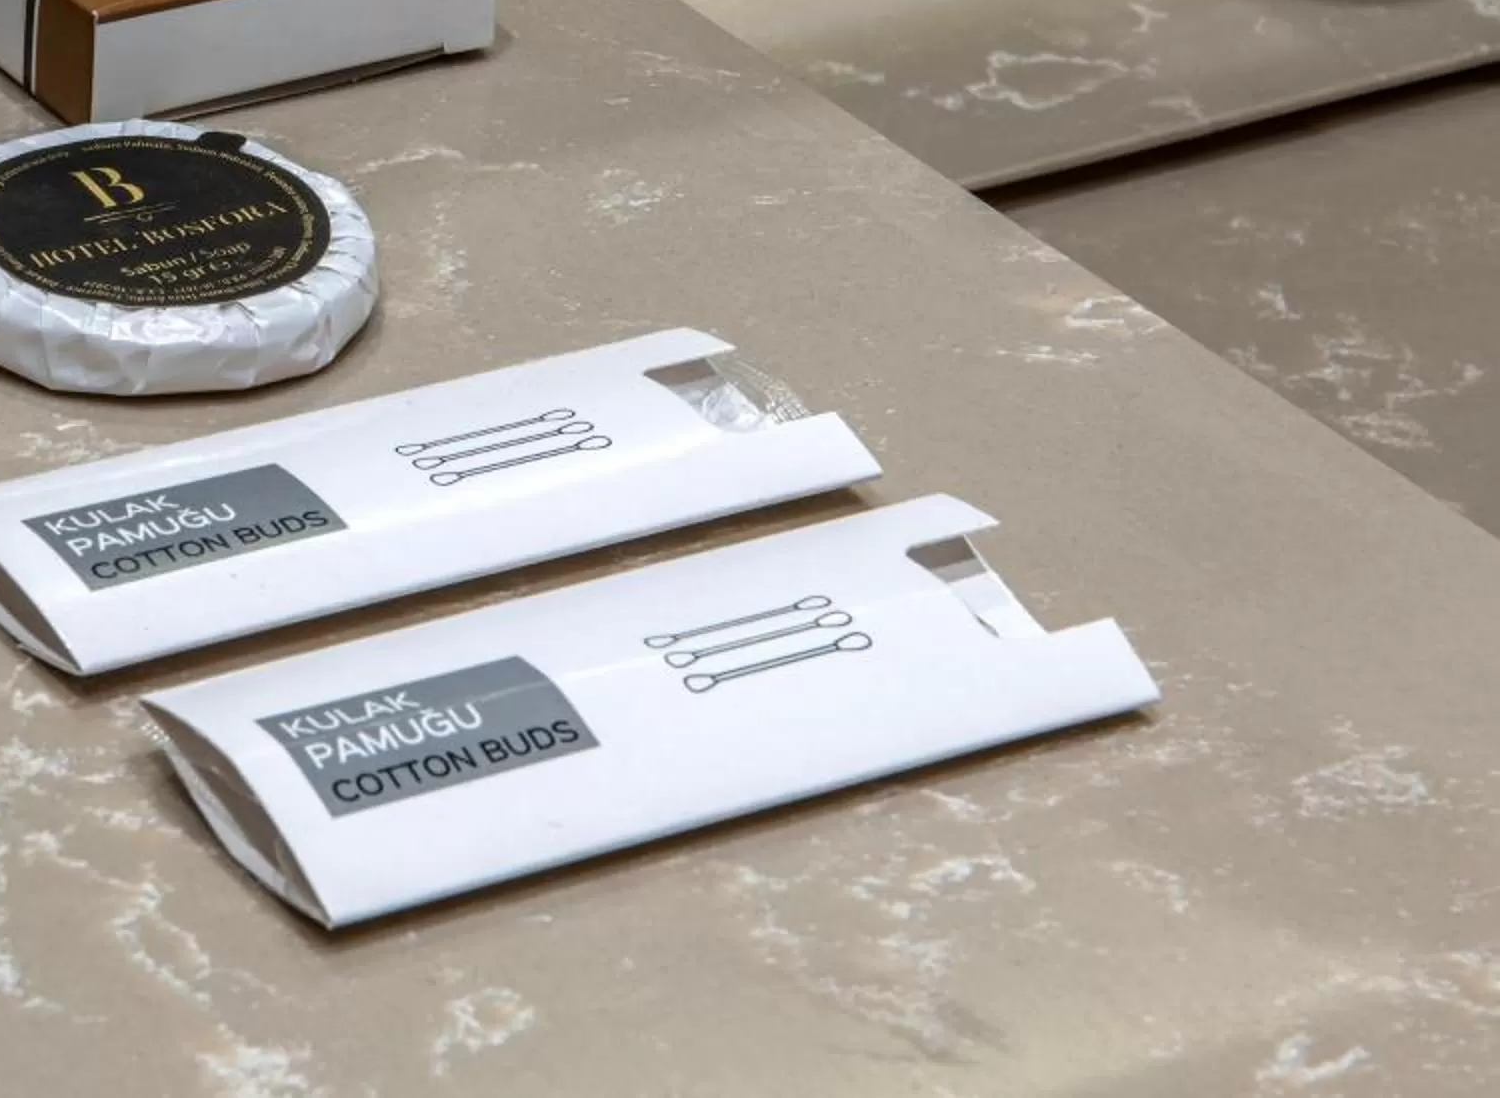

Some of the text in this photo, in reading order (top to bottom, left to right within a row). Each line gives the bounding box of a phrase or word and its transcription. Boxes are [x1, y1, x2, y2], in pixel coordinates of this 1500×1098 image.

[69, 166, 146, 208] B
[29, 236, 139, 270] HOTEL
[137, 201, 288, 247] BOSFORA
[120, 255, 187, 277] Sabun
[198, 241, 251, 260] Soap
[44, 493, 181, 536] KULAK
[67, 503, 238, 558] PAMUĞU
[91, 510, 330, 581] COTTON BUDS
[279, 690, 421, 739] KULAK
[303, 702, 484, 770] PAMUĞU
[331, 719, 580, 804] COTTON BUDS
